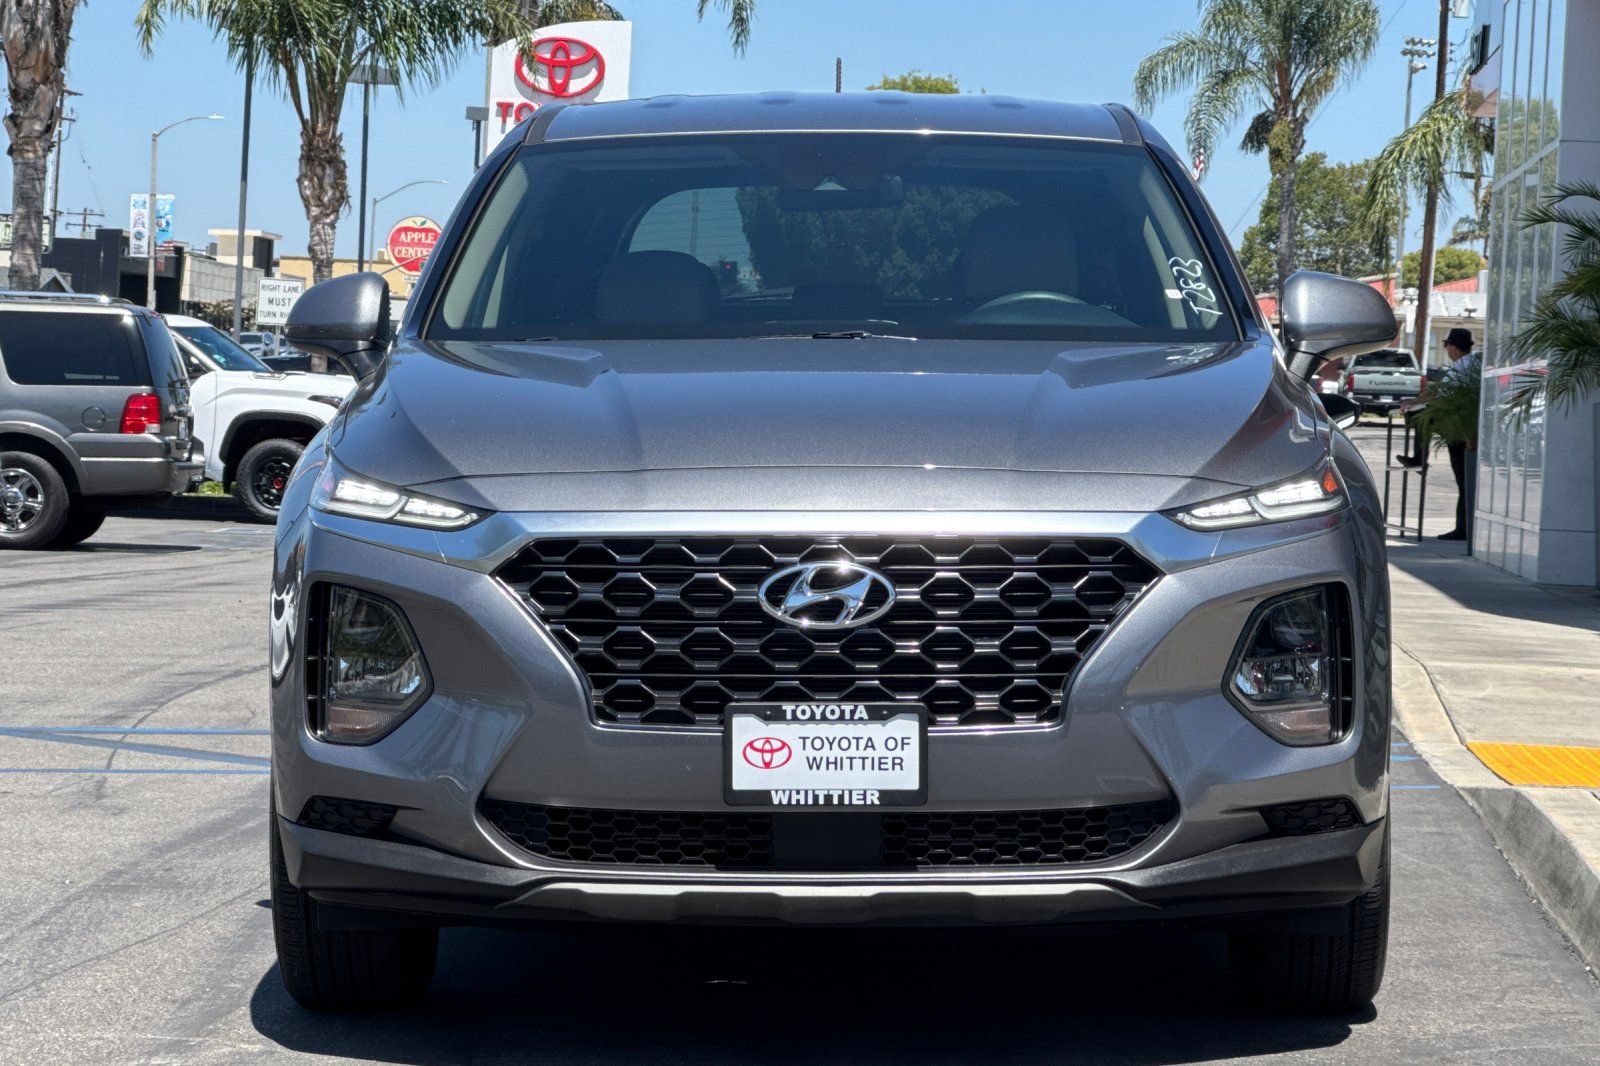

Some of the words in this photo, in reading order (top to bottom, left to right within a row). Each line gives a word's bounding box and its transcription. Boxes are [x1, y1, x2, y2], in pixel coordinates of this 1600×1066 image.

[399, 231, 436, 244] APPLE
[394, 246, 432, 258] CENTE
[261, 284, 281, 292] RIGHT
[283, 285, 300, 293] LANE
[267, 297, 292, 306] MUST
[260, 310, 277, 318] TURN
[782, 704, 869, 720] TOYOTA
[799, 736, 876, 751] TOYOTA
[884, 736, 911, 751] OF
[806, 756, 904, 771] WHITTIER
[770, 789, 880, 805] WHITTIER
